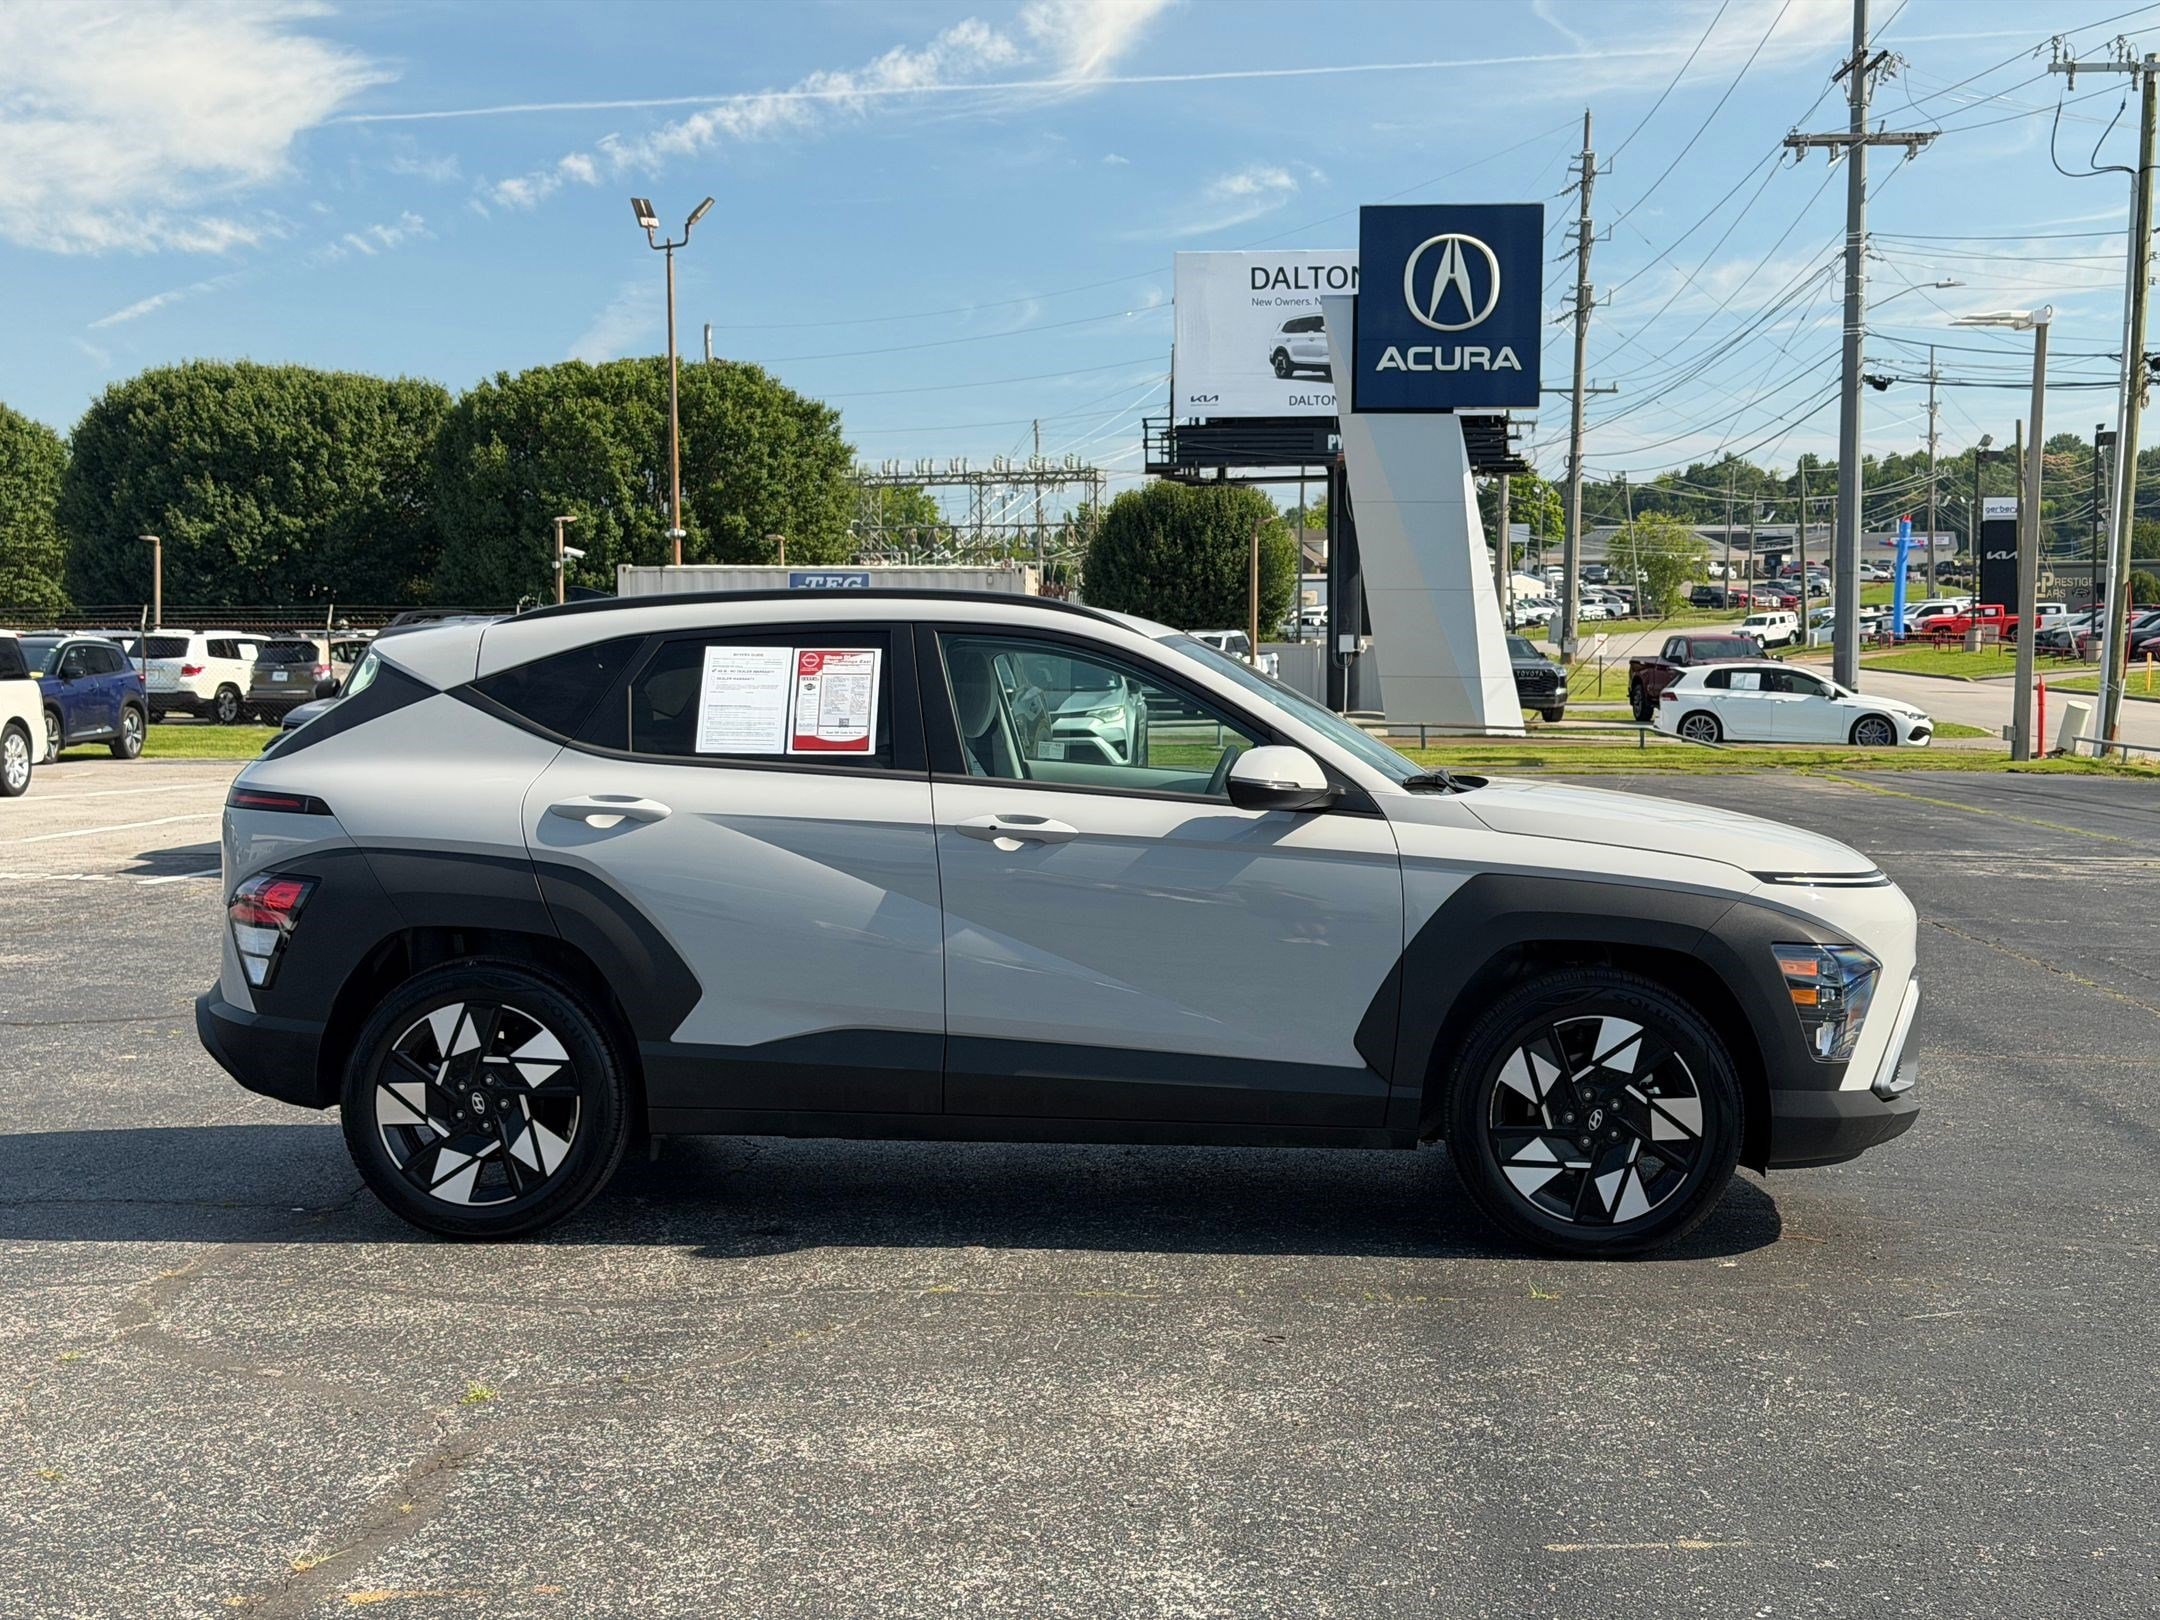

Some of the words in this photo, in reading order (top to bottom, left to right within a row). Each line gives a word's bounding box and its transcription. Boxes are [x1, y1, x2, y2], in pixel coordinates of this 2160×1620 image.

[1252, 298, 1272, 306] New
[1275, 297, 1311, 306] Owners.
[1375, 346, 1522, 371] ACURA
[1986, 550, 2017, 560] KIA
[2042, 572, 2093, 593] PRESTIGE
